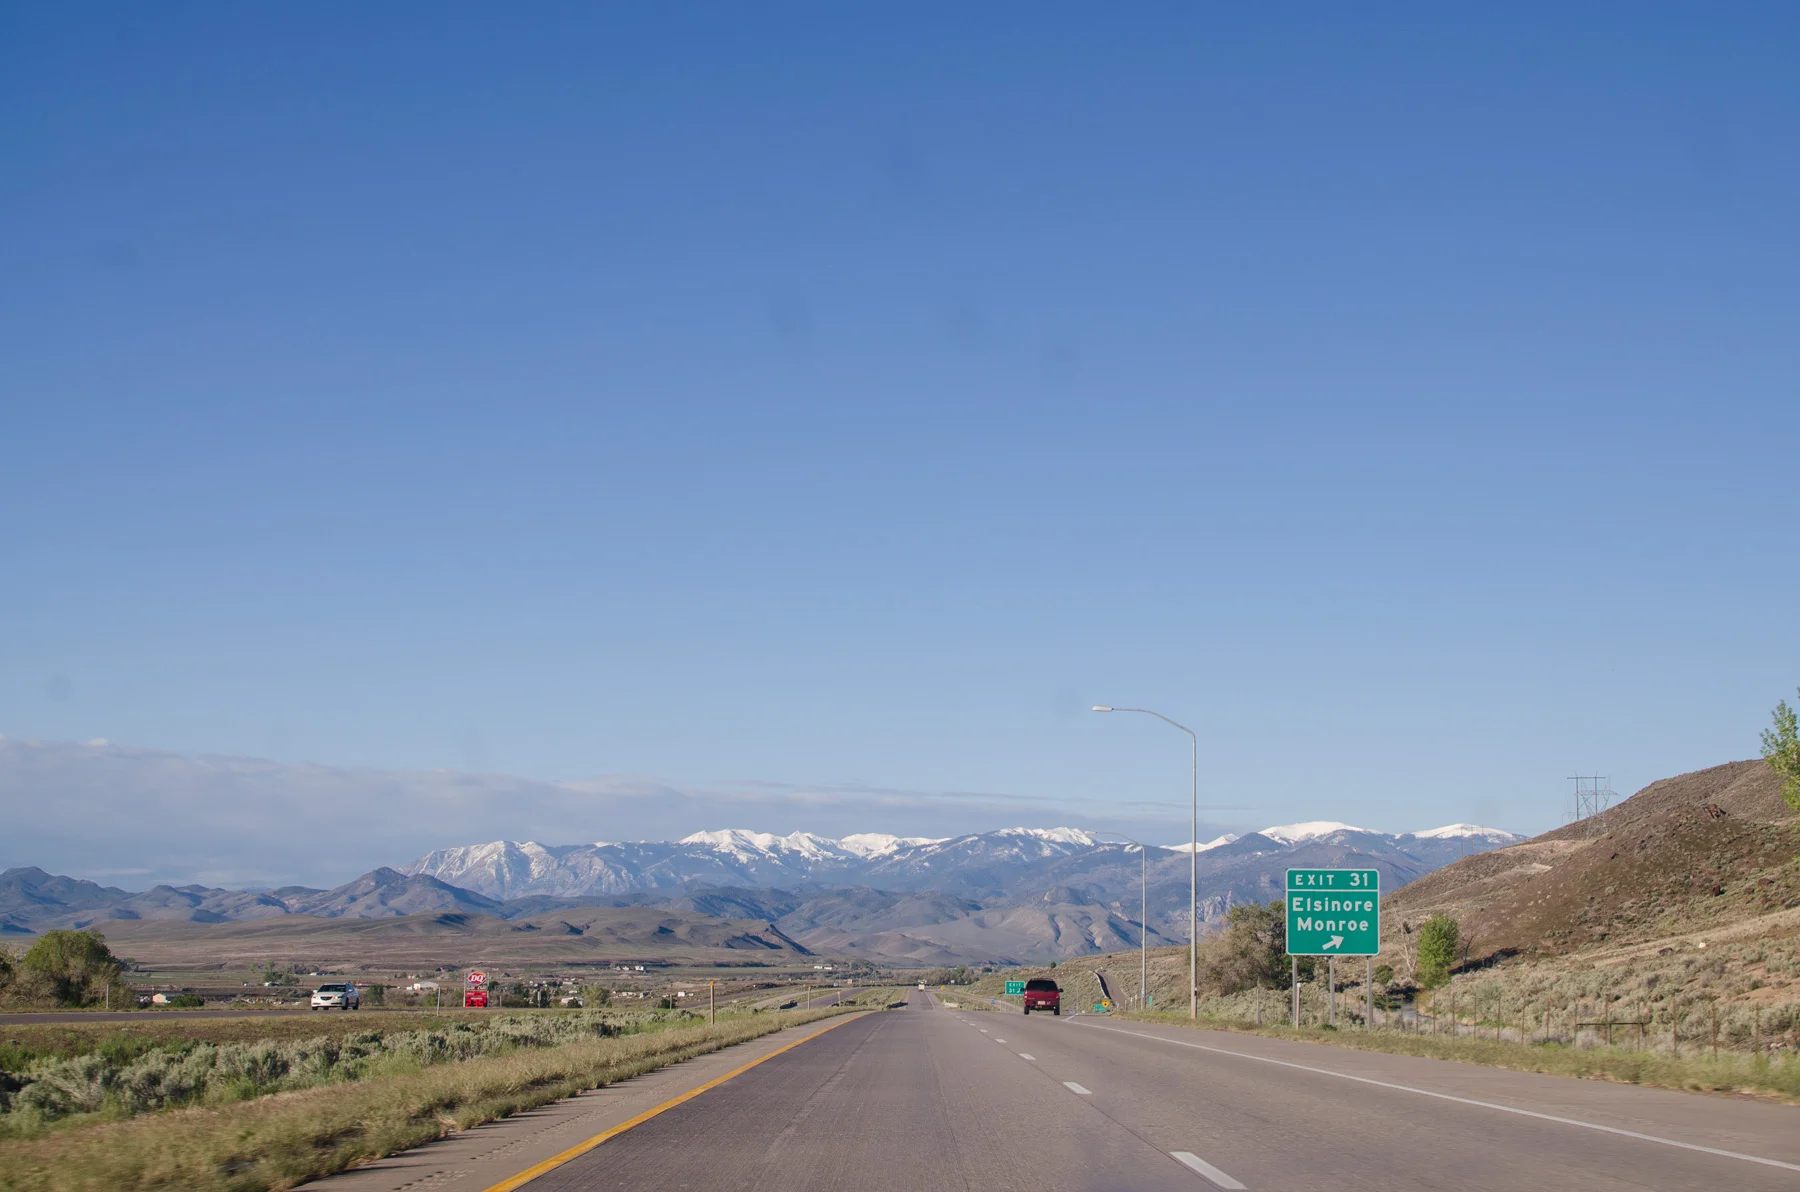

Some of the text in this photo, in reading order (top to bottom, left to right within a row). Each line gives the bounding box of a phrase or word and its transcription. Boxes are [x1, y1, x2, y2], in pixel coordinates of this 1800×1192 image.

[1295, 873, 1368, 886] EXIT 31
[1293, 897, 1373, 911] Elsinore
[1297, 917, 1369, 931] Monroe
[470, 974, 484, 982] DQ
